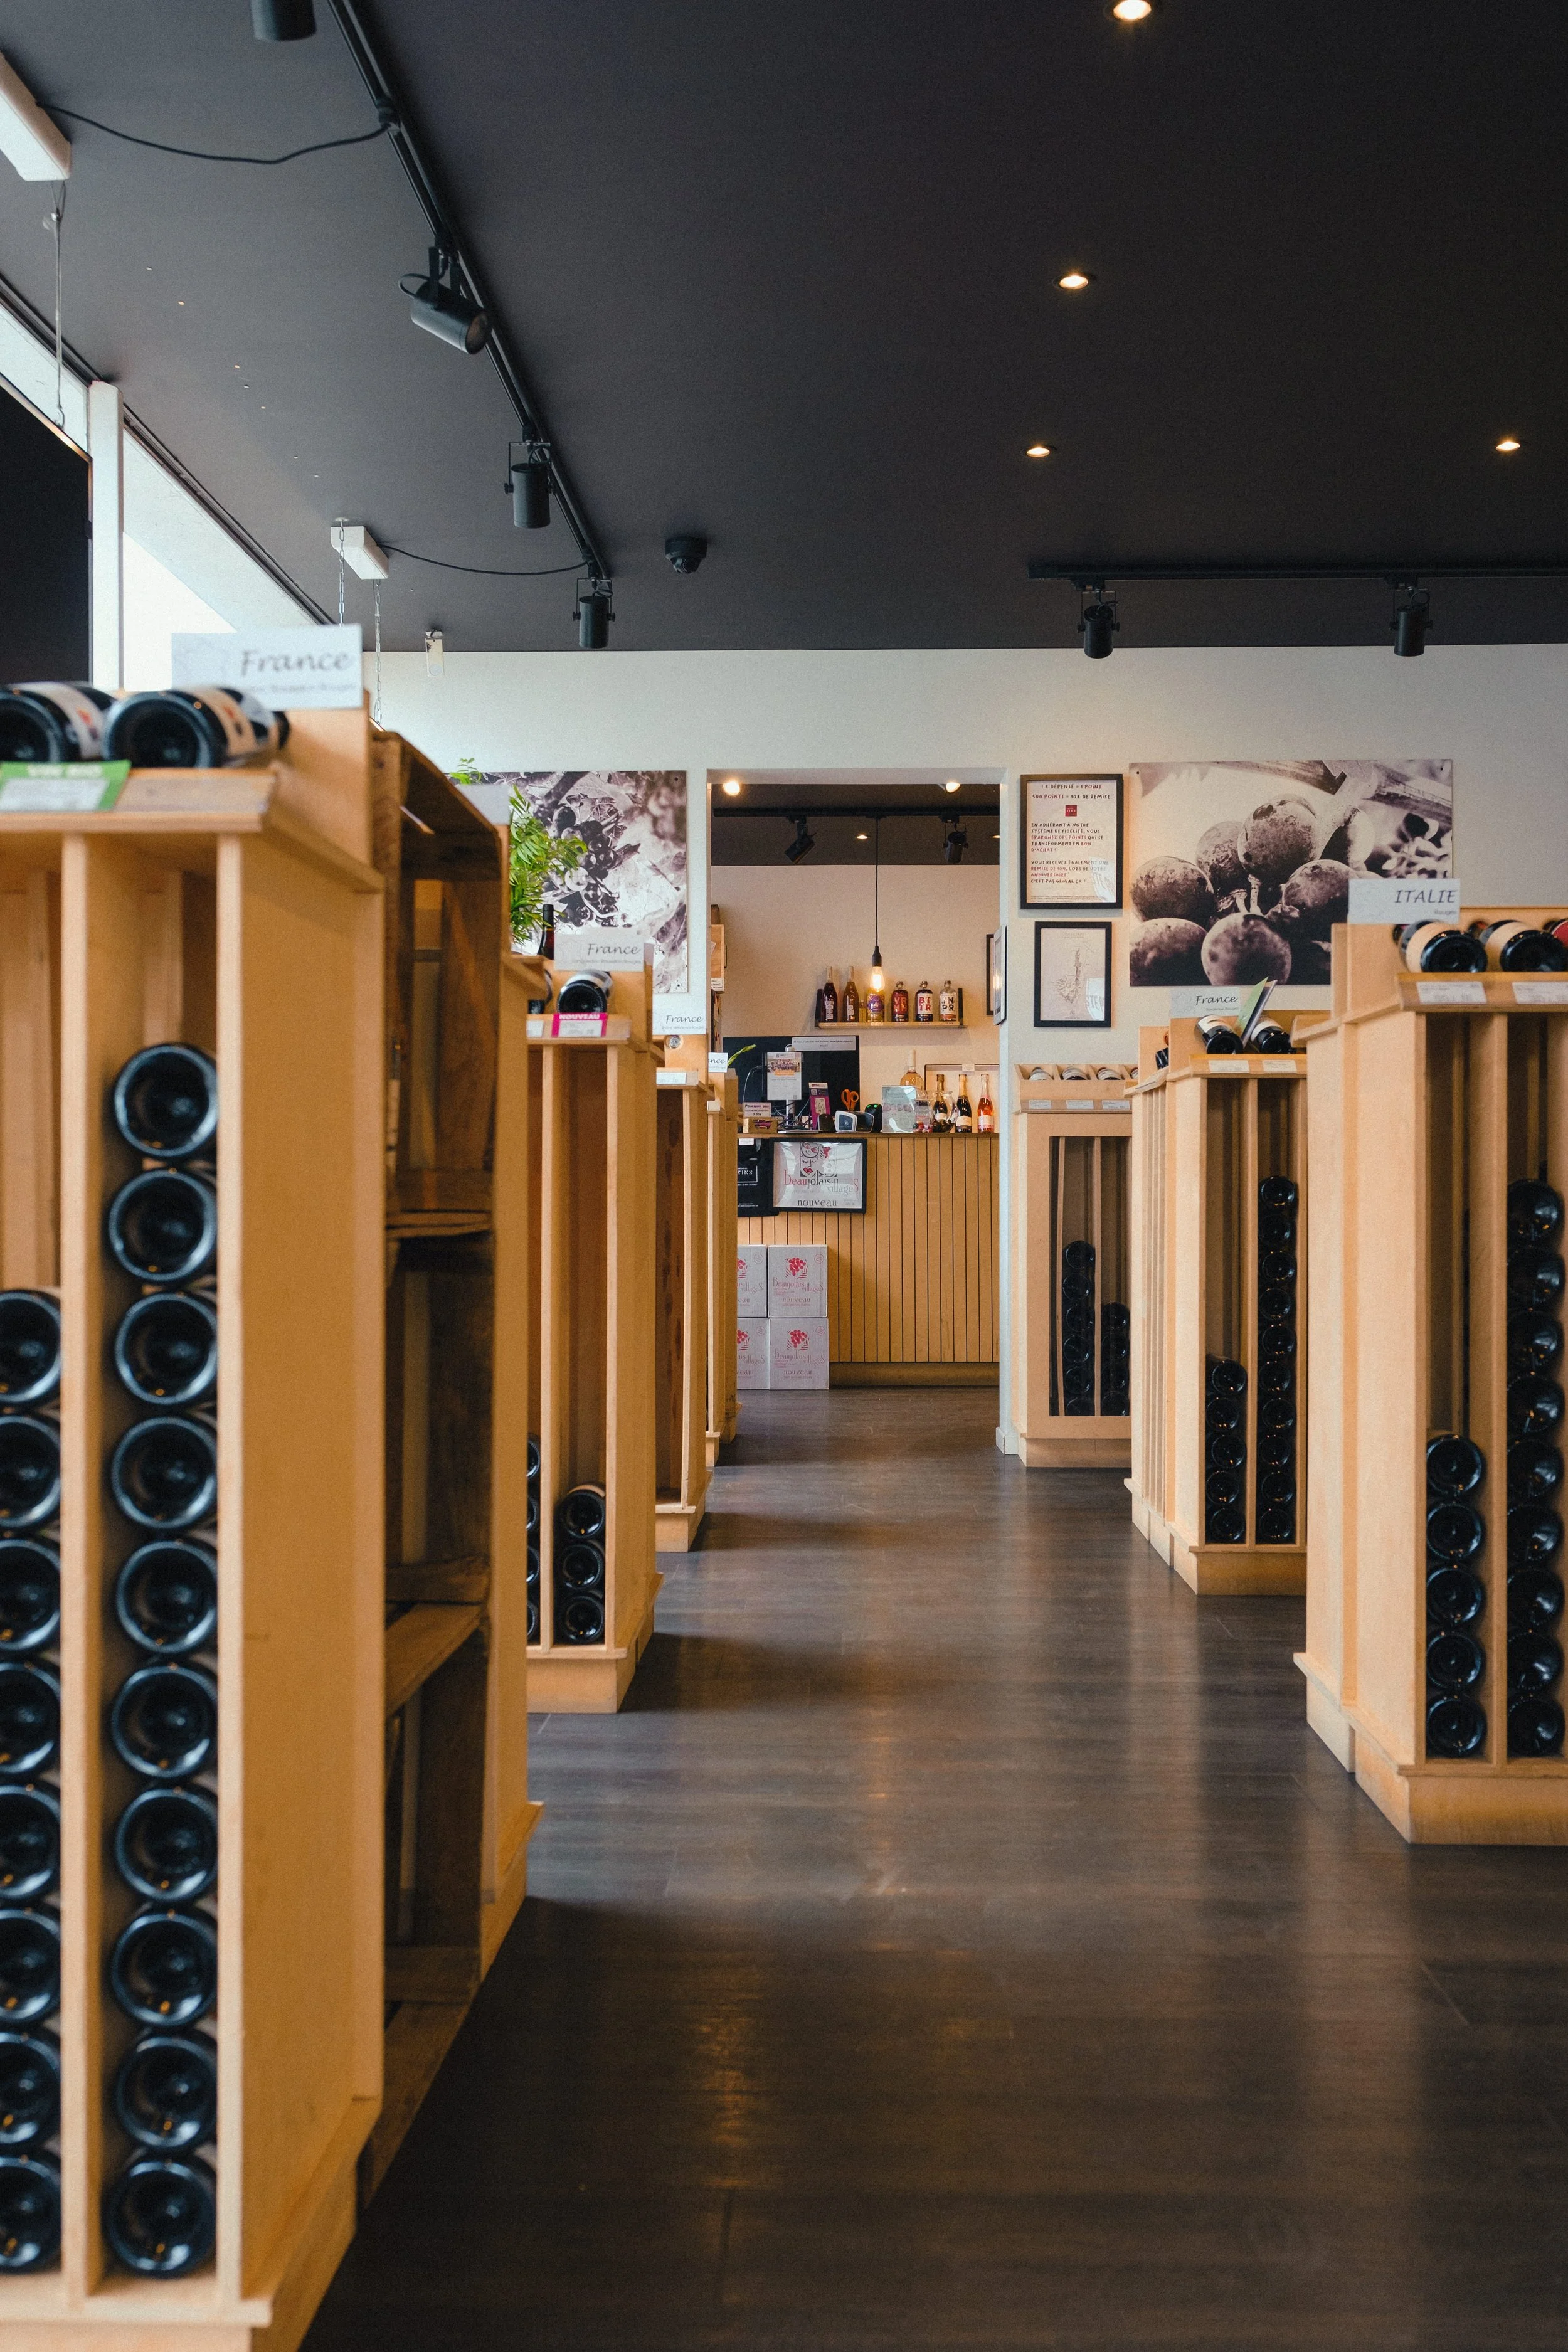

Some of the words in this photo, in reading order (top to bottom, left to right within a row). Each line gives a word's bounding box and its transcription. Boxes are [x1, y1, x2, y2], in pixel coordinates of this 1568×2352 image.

[240, 650, 351, 677] France
[1394, 889, 1458, 904] ITALIE
[587, 943, 641, 956] France
[1195, 994, 1239, 1005] France
[665, 1015, 704, 1024] France
[797, 1199, 837, 1207] nouveau
